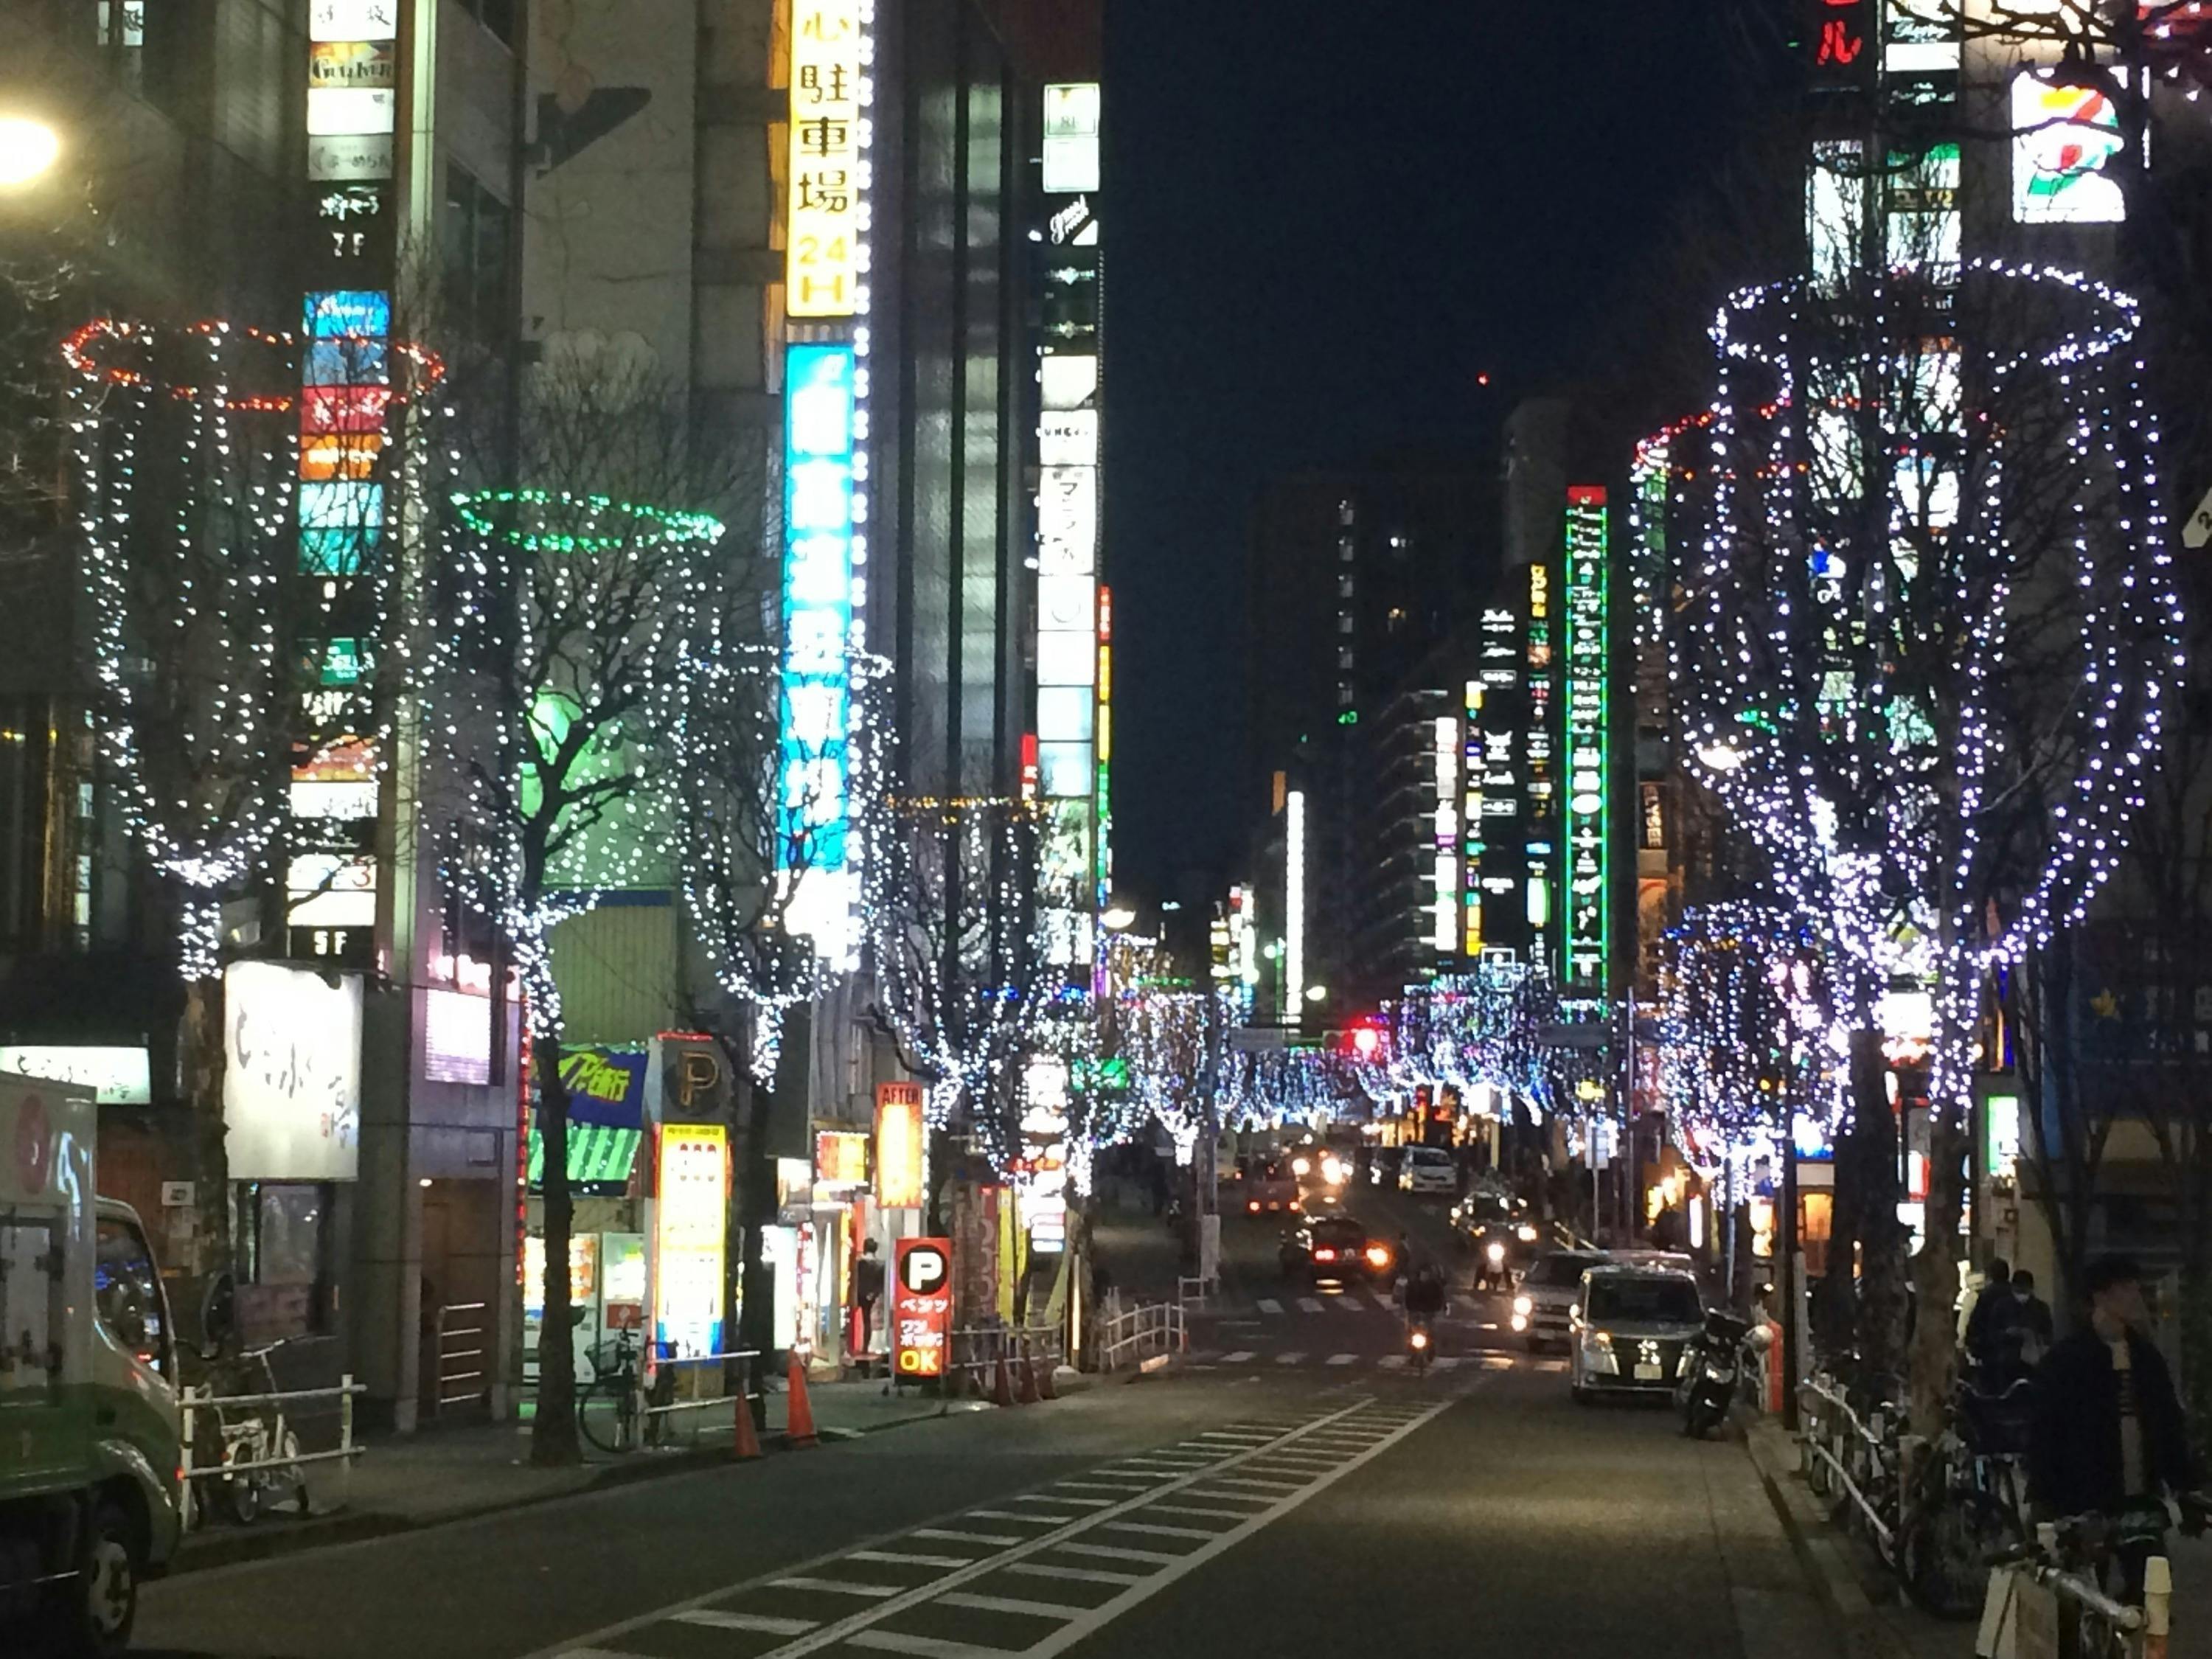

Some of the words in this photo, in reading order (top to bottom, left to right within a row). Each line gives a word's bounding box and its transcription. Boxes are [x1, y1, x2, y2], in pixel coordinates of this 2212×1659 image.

[680, 1051, 720, 1106] P
[908, 1252, 943, 1290] P
[900, 1349, 938, 1372] OK
